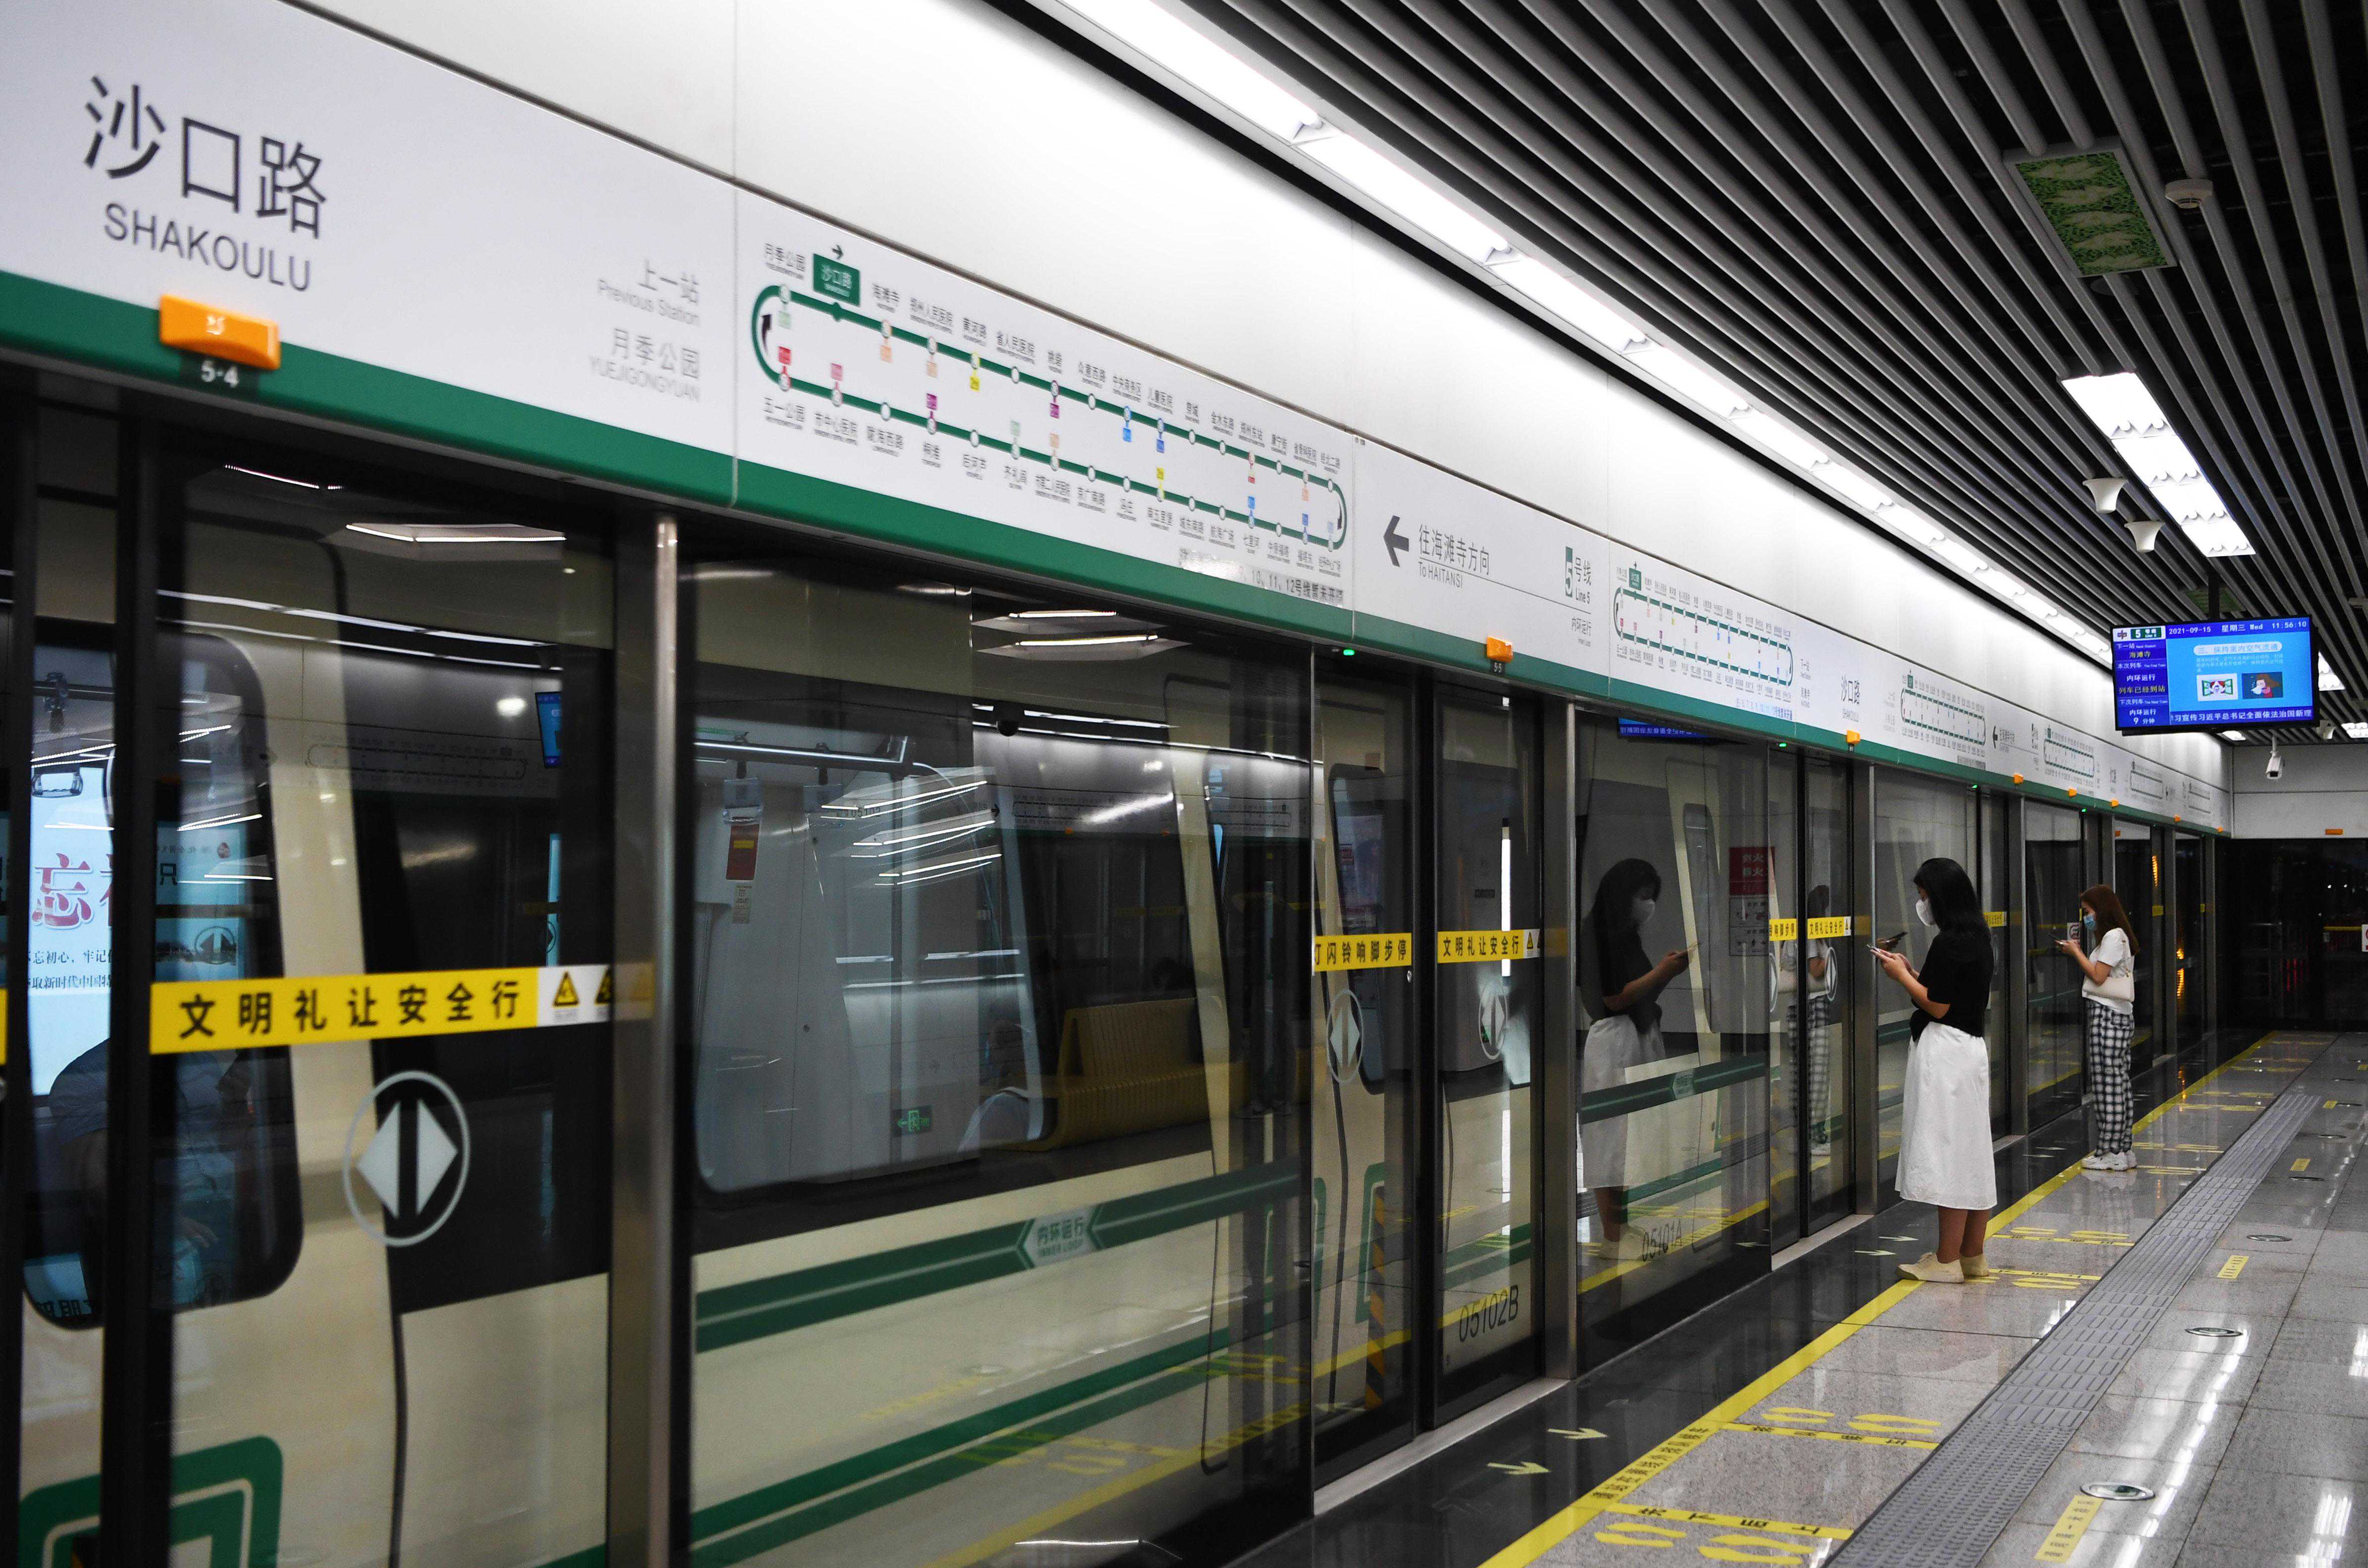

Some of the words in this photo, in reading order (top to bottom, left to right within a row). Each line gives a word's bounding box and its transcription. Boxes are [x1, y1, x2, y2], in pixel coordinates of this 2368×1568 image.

[84, 75, 327, 240] 沙口路
[104, 202, 311, 292] SHAKOULU
[638, 259, 698, 306] 上一站
[596, 277, 654, 313] Previous
[657, 297, 700, 327] Station
[610, 327, 699, 381] 月季公园
[1419, 525, 1489, 575] 往海滩寺方向
[1418, 561, 1427, 577] To
[1428, 564, 1463, 588] HAITANSI
[1575, 557, 1591, 586] 号线
[1575, 588, 1586, 603] Line
[1586, 591, 1590, 604] 5
[2135, 629, 2141, 638] 5
[2169, 626, 2212, 635] 2021-09-15
[2221, 624, 2246, 633] 星期三
[2272, 621, 2307, 629] 11:56:10
[1841, 674, 1860, 705] 沙口路
[2119, 686, 2166, 694] 列车已经到站
[1442, 935, 1519, 957] 文明礼让安全行
[179, 980, 521, 1039] 文明礼让安全行
[1459, 1284, 1519, 1343] 05102B
